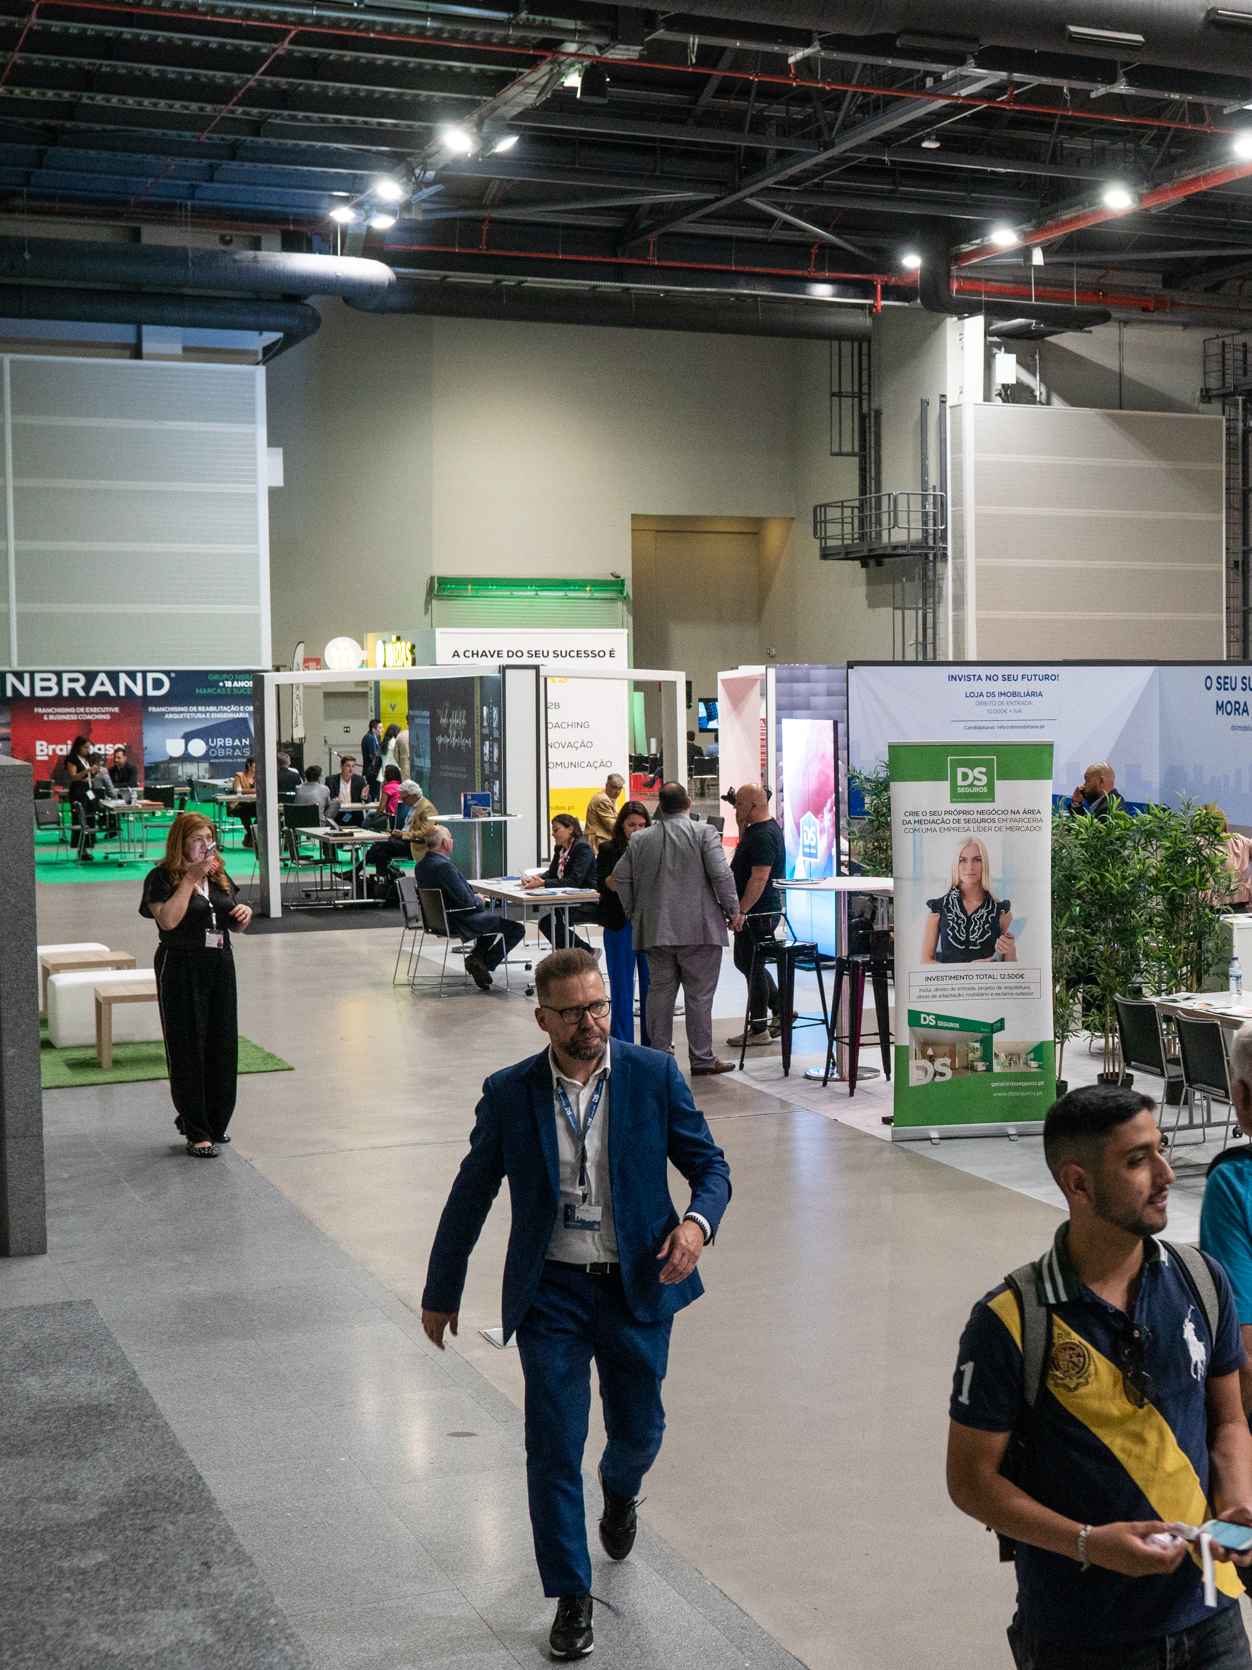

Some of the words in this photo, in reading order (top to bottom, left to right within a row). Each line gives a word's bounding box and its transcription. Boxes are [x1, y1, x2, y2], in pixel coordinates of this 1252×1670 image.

[452, 650, 461, 658] A
[463, 650, 503, 658] CHAVE
[506, 650, 524, 658] DO
[527, 650, 550, 658] SEU
[552, 650, 606, 658] SUCESSO
[609, 647, 616, 658] É
[948, 674, 983, 682] INVISTA
[1021, 673, 1060, 681] FUTURO!
[1205, 675, 1213, 691] O
[1216, 675, 1237, 691] SEU
[6, 672, 171, 697] NBRAND
[997, 689, 1043, 698] IMOBILIÁRIA
[547, 702, 560, 710] 2B
[1216, 700, 1249, 716] MORA
[547, 721, 590, 729] OACHING
[209, 738, 250, 746] URBAN
[547, 739, 593, 751] NOVAÇÃO
[209, 748, 250, 757] OBRAS
[547, 759, 613, 770] OMUNICAÇÃO
[956, 766, 988, 786] DS
[944, 808, 975, 816] PRÓPRIO
[976, 807, 1009, 815] NEGÓCIO
[1022, 807, 1042, 815] ÁREA
[913, 817, 951, 825] MEDIAÇÃO
[803, 825, 817, 846] DS
[920, 1013, 936, 1026] DS
[937, 1020, 960, 1028] SEGUROS
[909, 1058, 953, 1087] DS
[958, 1361, 975, 1406] 1
